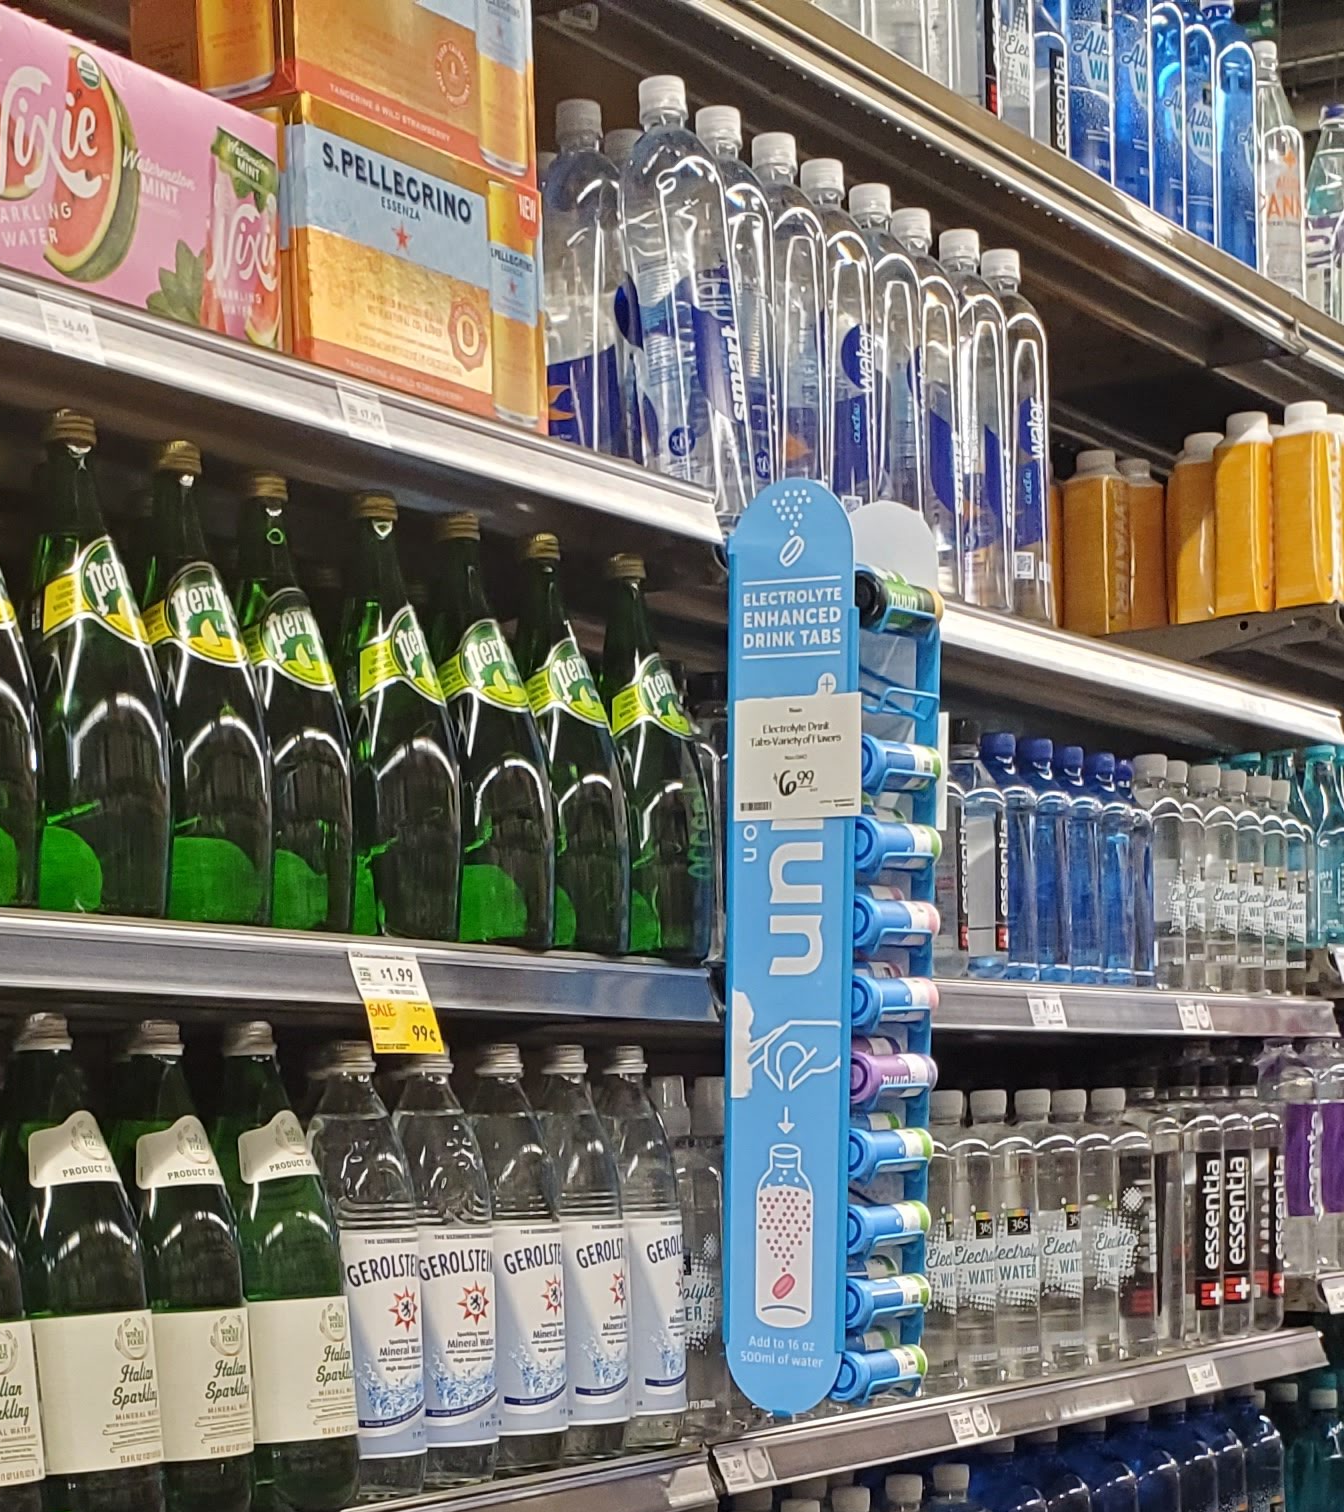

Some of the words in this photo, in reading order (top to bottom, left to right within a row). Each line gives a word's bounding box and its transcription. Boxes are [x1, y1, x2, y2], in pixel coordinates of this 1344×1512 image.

[329, 83, 372, 110] TANGERINE
[381, 107, 401, 123] WILD
[401, 115, 451, 142] STRAWBERRY
[122, 146, 197, 191] Watermelon
[236, 156, 262, 181] MINT
[141, 179, 180, 205] MINT
[322, 141, 472, 226] S.PELLEGRINO
[381, 196, 421, 222] ESSENZA
[518, 192, 537, 223] NEW
[1, 225, 59, 246] WATER
[743, 587, 842, 607] ELECTROLYTE
[742, 606, 842, 628] ENHANCED
[743, 632, 795, 649] DRINK
[800, 628, 842, 645] TABS
[380, 968, 413, 982] $1.99
[369, 1003, 396, 1017] SALE
[412, 1025, 437, 1042] 99¢
[62, 1166, 99, 1178] PRODUCT
[1205, 1159, 1220, 1269] essentia
[1228, 1157, 1247, 1265] essentia
[1012, 1216, 1030, 1232] 365
[749, 1336, 768, 1349] Add
[774, 1337, 783, 1349] to
[788, 1338, 799, 1350] 16
[803, 1341, 815, 1351] oz
[740, 1352, 773, 1367] 500ml
[777, 1353, 786, 1366] of
[790, 1356, 823, 1368] water
